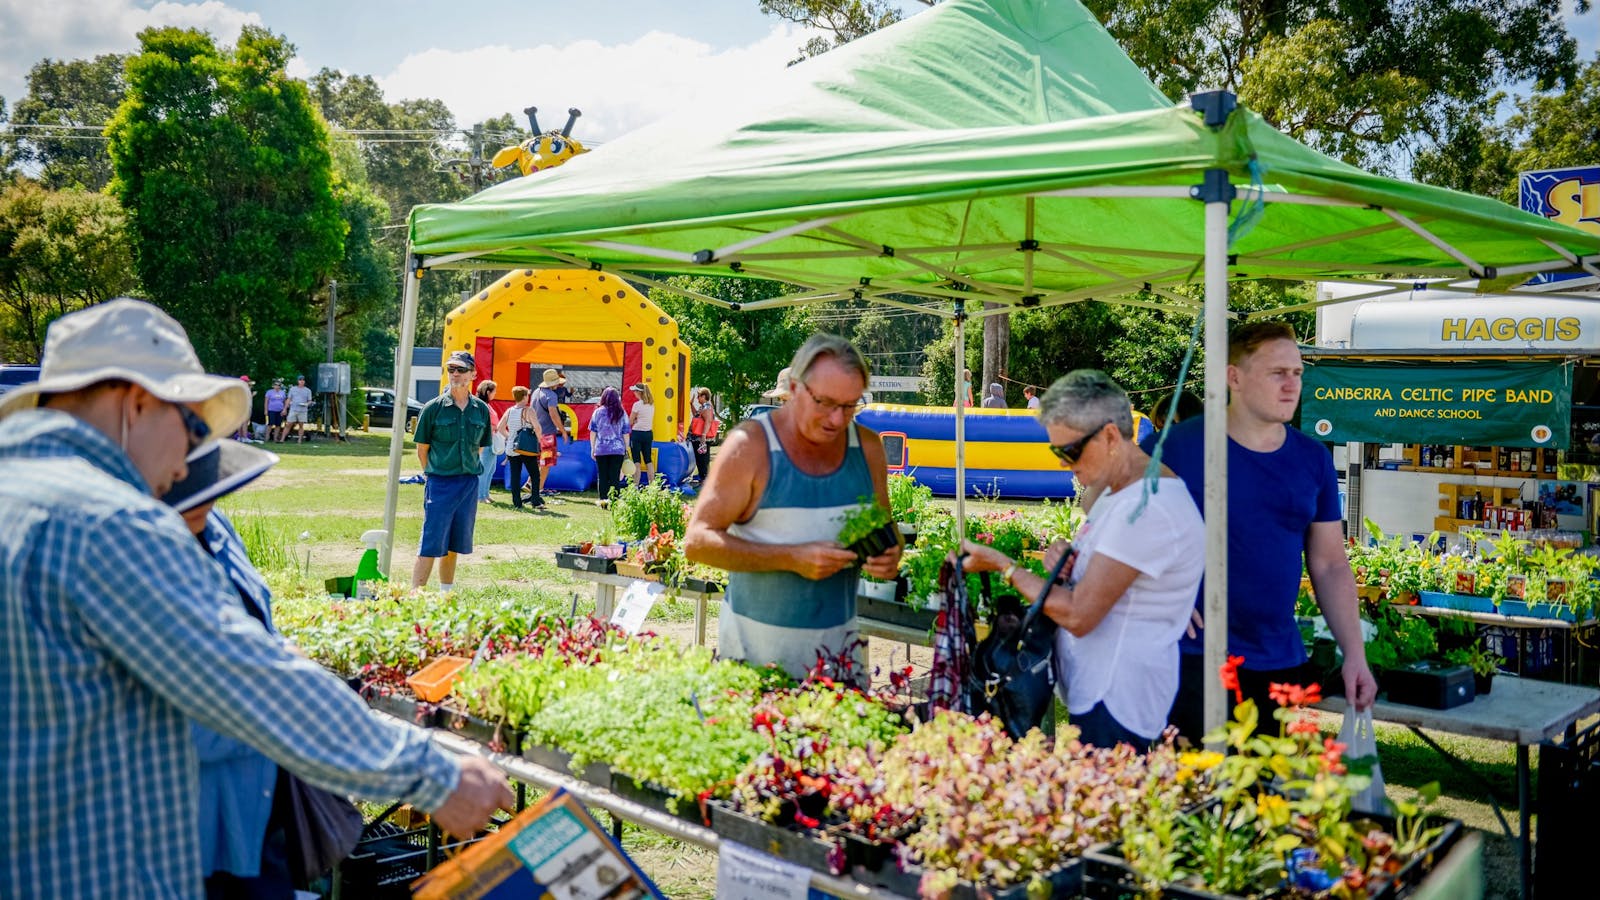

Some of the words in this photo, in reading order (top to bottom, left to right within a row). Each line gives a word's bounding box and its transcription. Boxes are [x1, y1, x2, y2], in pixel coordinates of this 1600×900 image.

[1442, 317, 1581, 341] HAGGIS
[1315, 387, 1392, 401] CANBERRA
[1401, 387, 1453, 402] CELTIC
[1462, 388, 1496, 403] PIPE
[1505, 389, 1553, 404] BAND
[1374, 408, 1397, 417] AND
[1399, 408, 1435, 418] DANCE
[1437, 409, 1482, 419] SCHOOL
